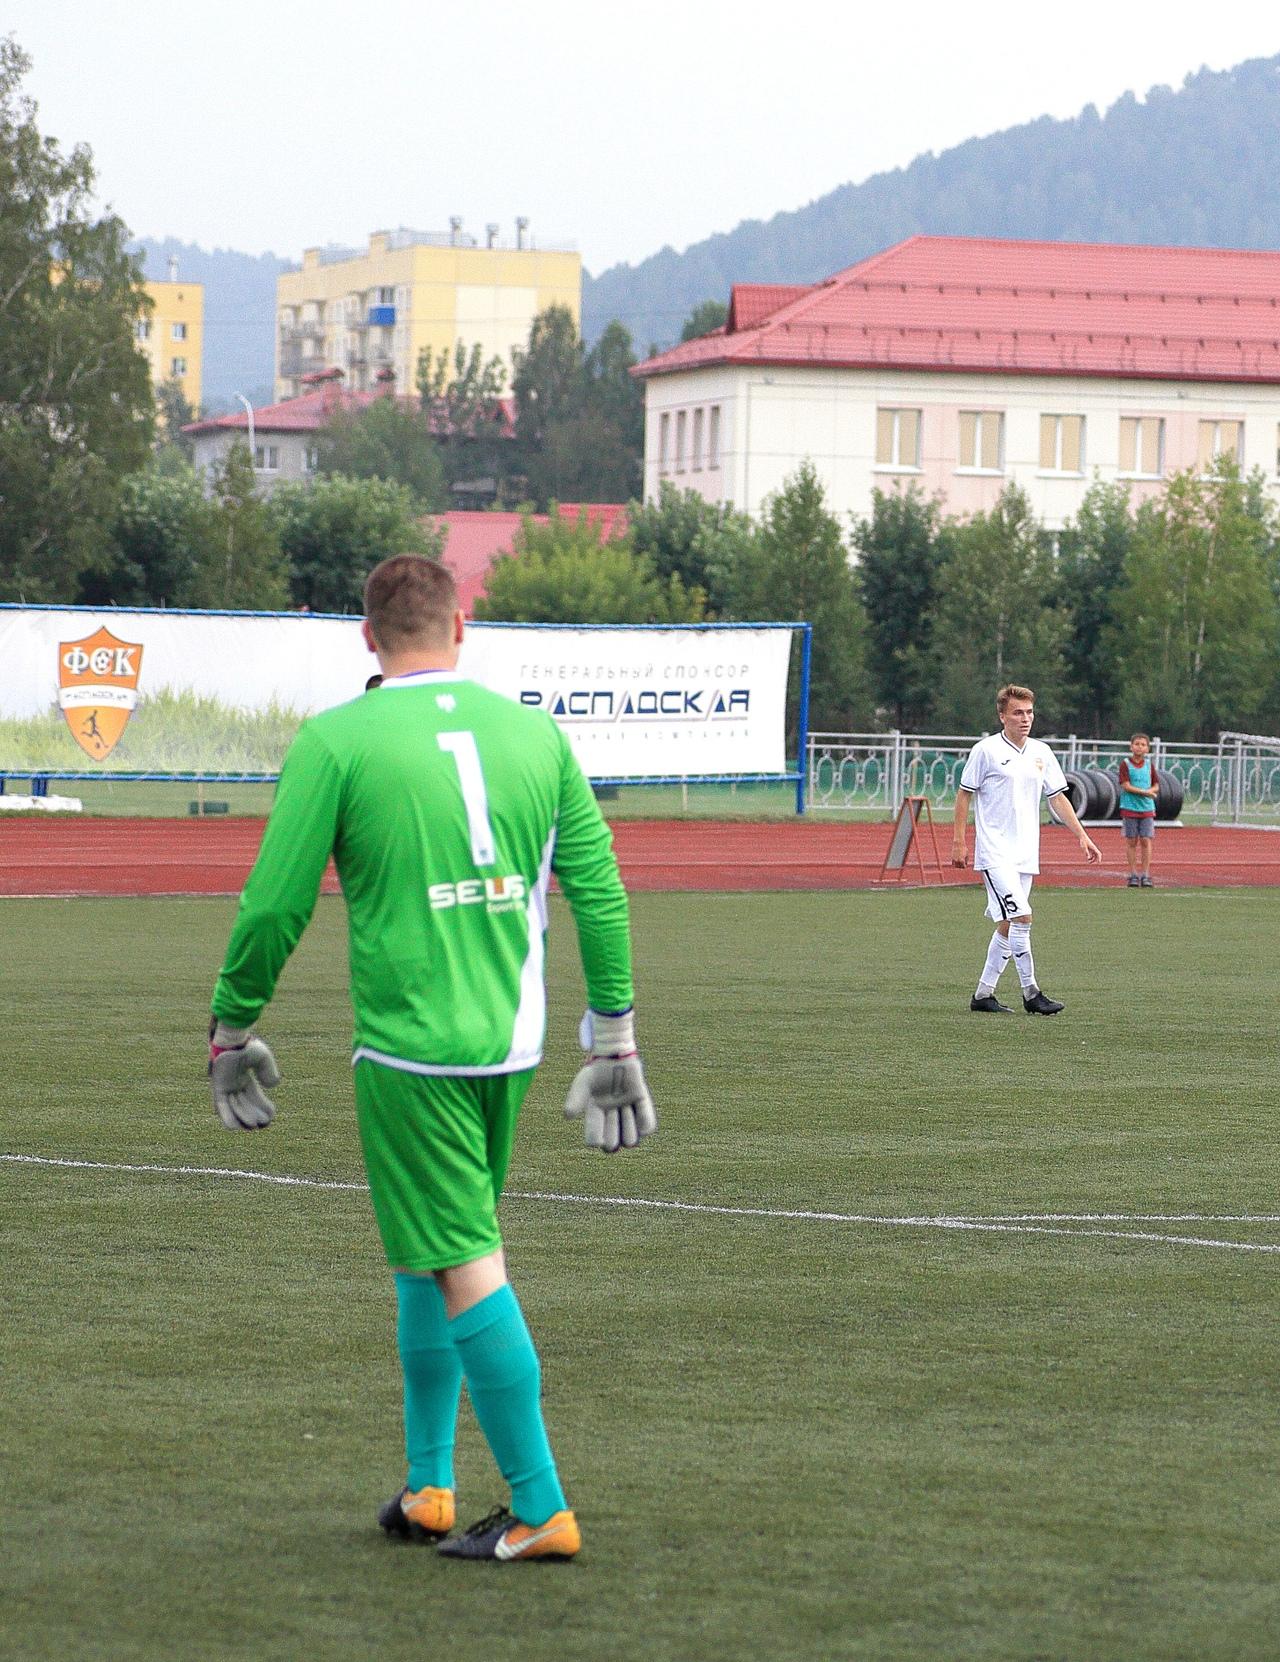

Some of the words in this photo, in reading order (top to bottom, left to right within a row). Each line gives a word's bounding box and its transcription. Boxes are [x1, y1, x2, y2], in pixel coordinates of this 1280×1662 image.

[663, 664, 749, 679] СПОНСОР
[435, 731, 496, 866] 1
[428, 875, 525, 909] SEUS
